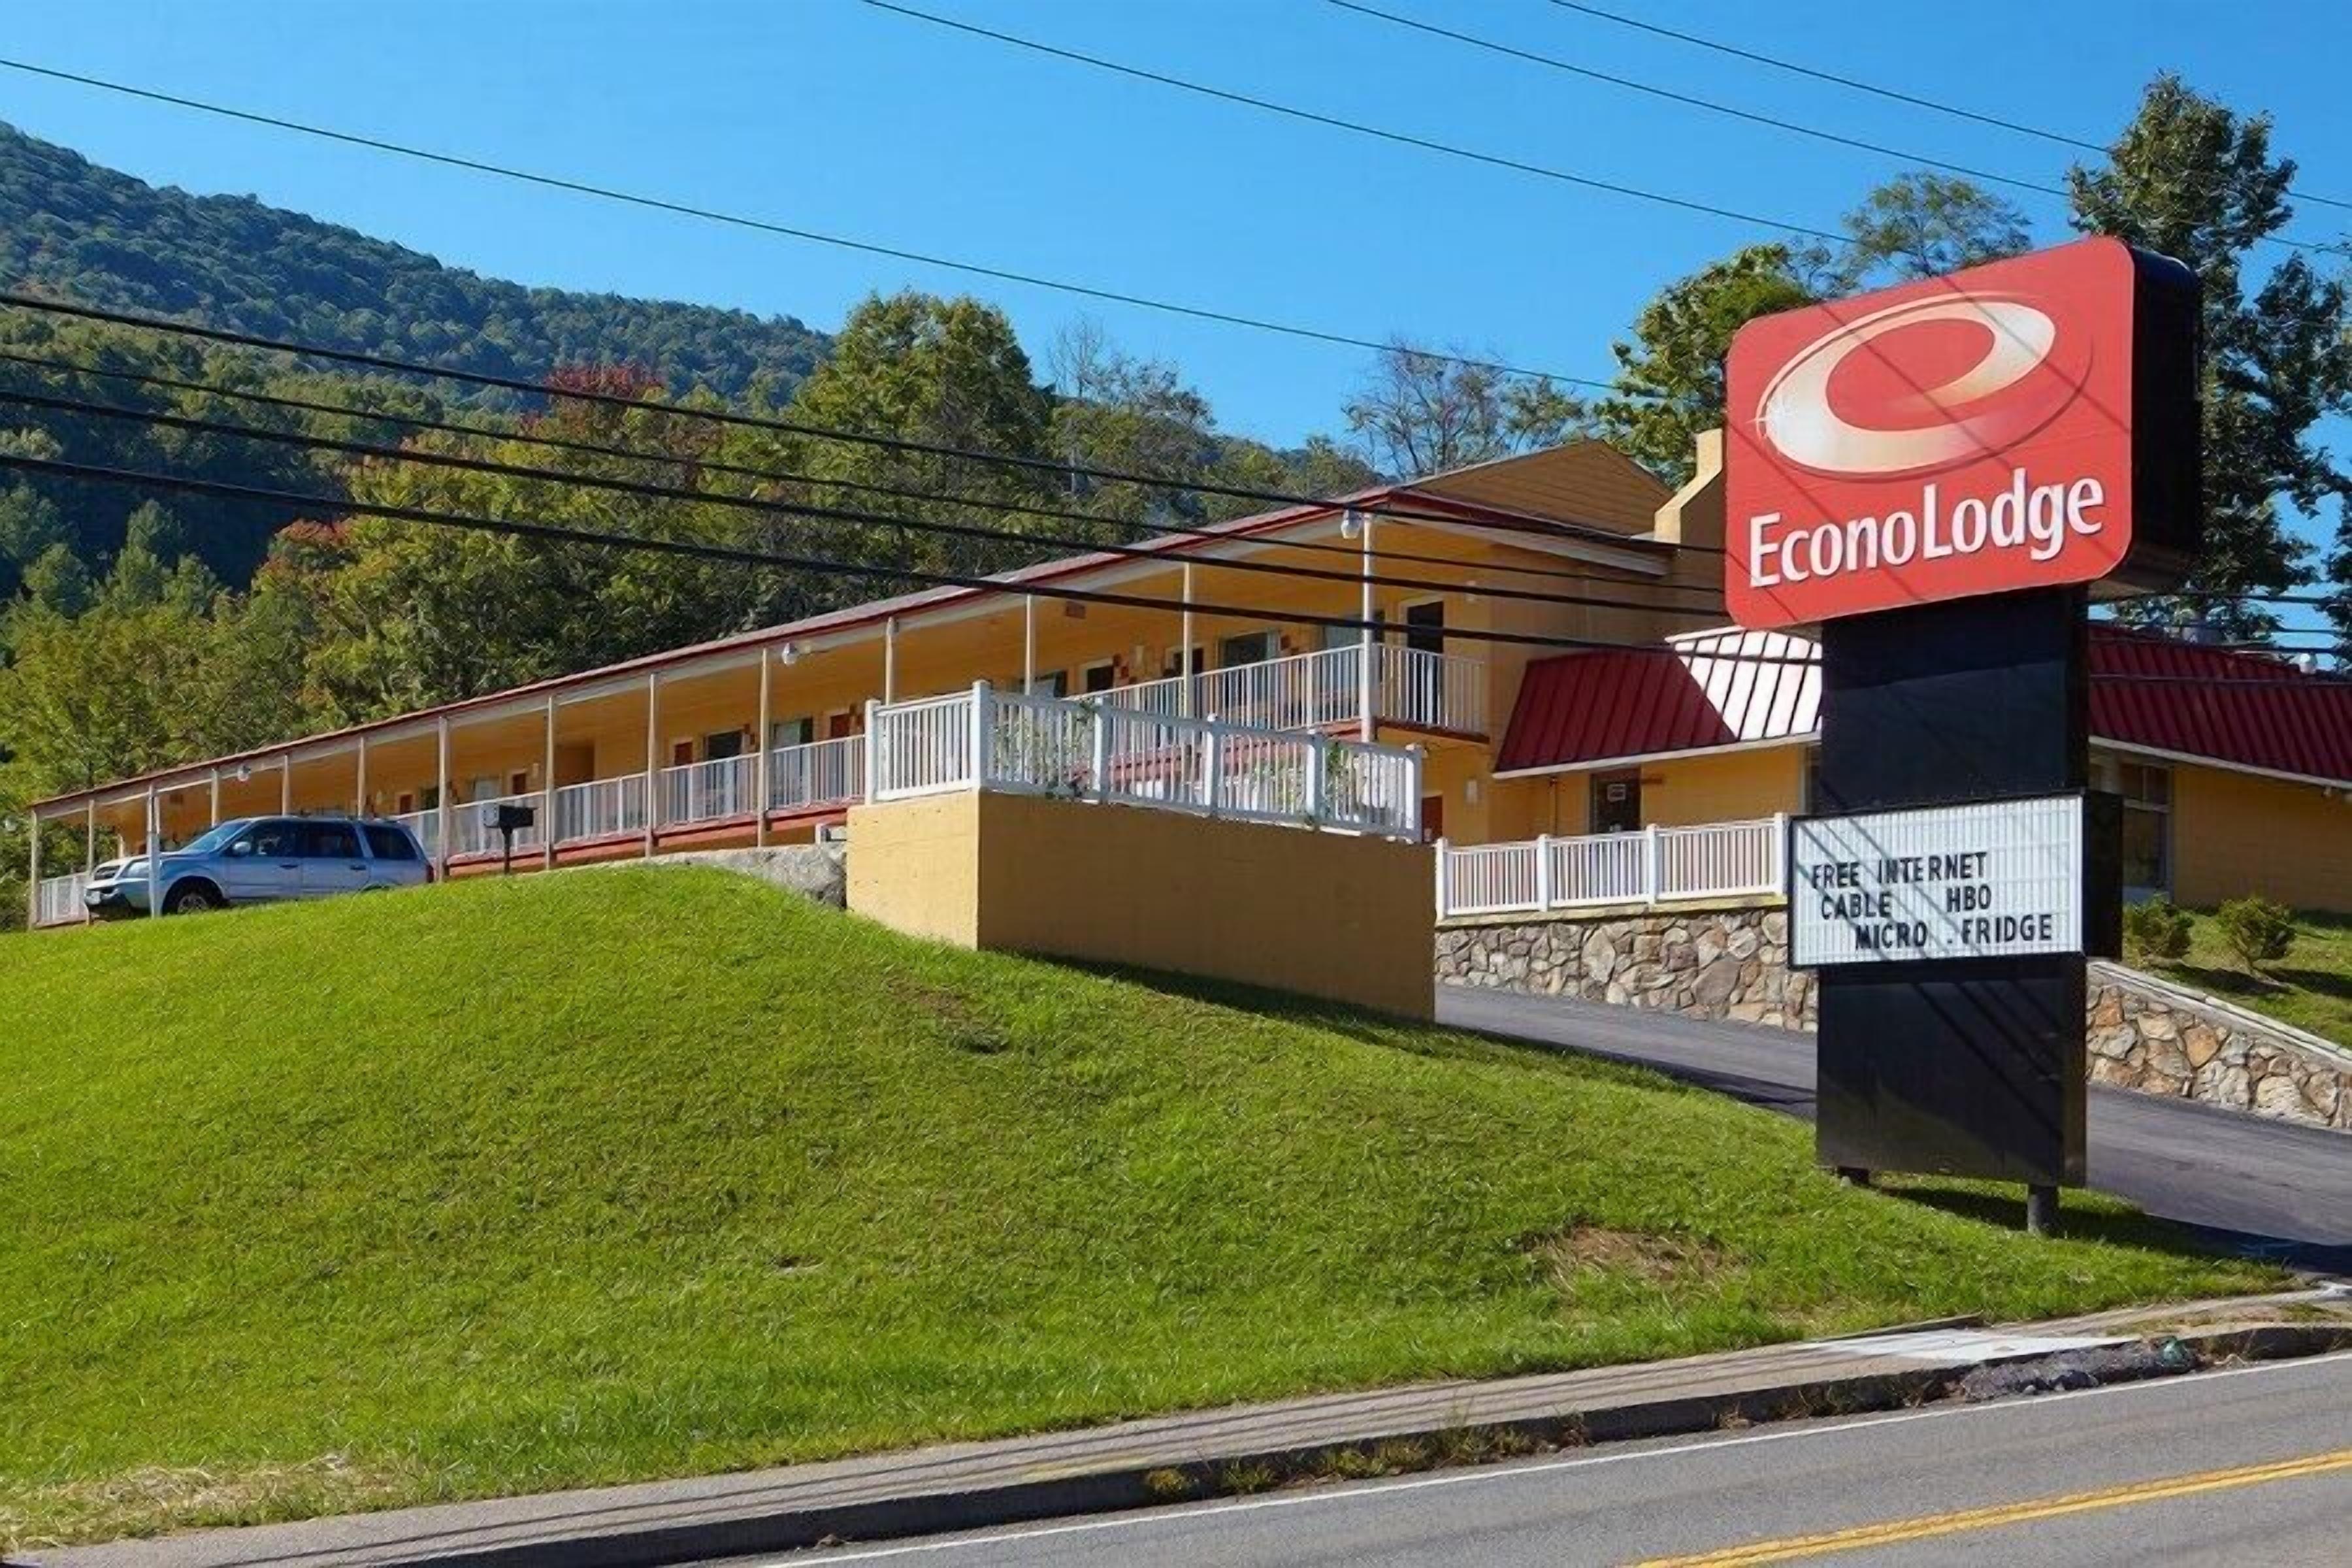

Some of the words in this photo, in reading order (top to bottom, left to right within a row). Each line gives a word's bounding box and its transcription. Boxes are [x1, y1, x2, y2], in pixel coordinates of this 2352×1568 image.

[1812, 862, 1860, 889] FREE
[1878, 852, 1987, 883] INTERNET
[1821, 891, 1893, 920] CABLE
[1947, 883, 1991, 913] HBO
[1855, 921, 1927, 949] MICRO
[1962, 914, 2053, 944] FRIDGE
